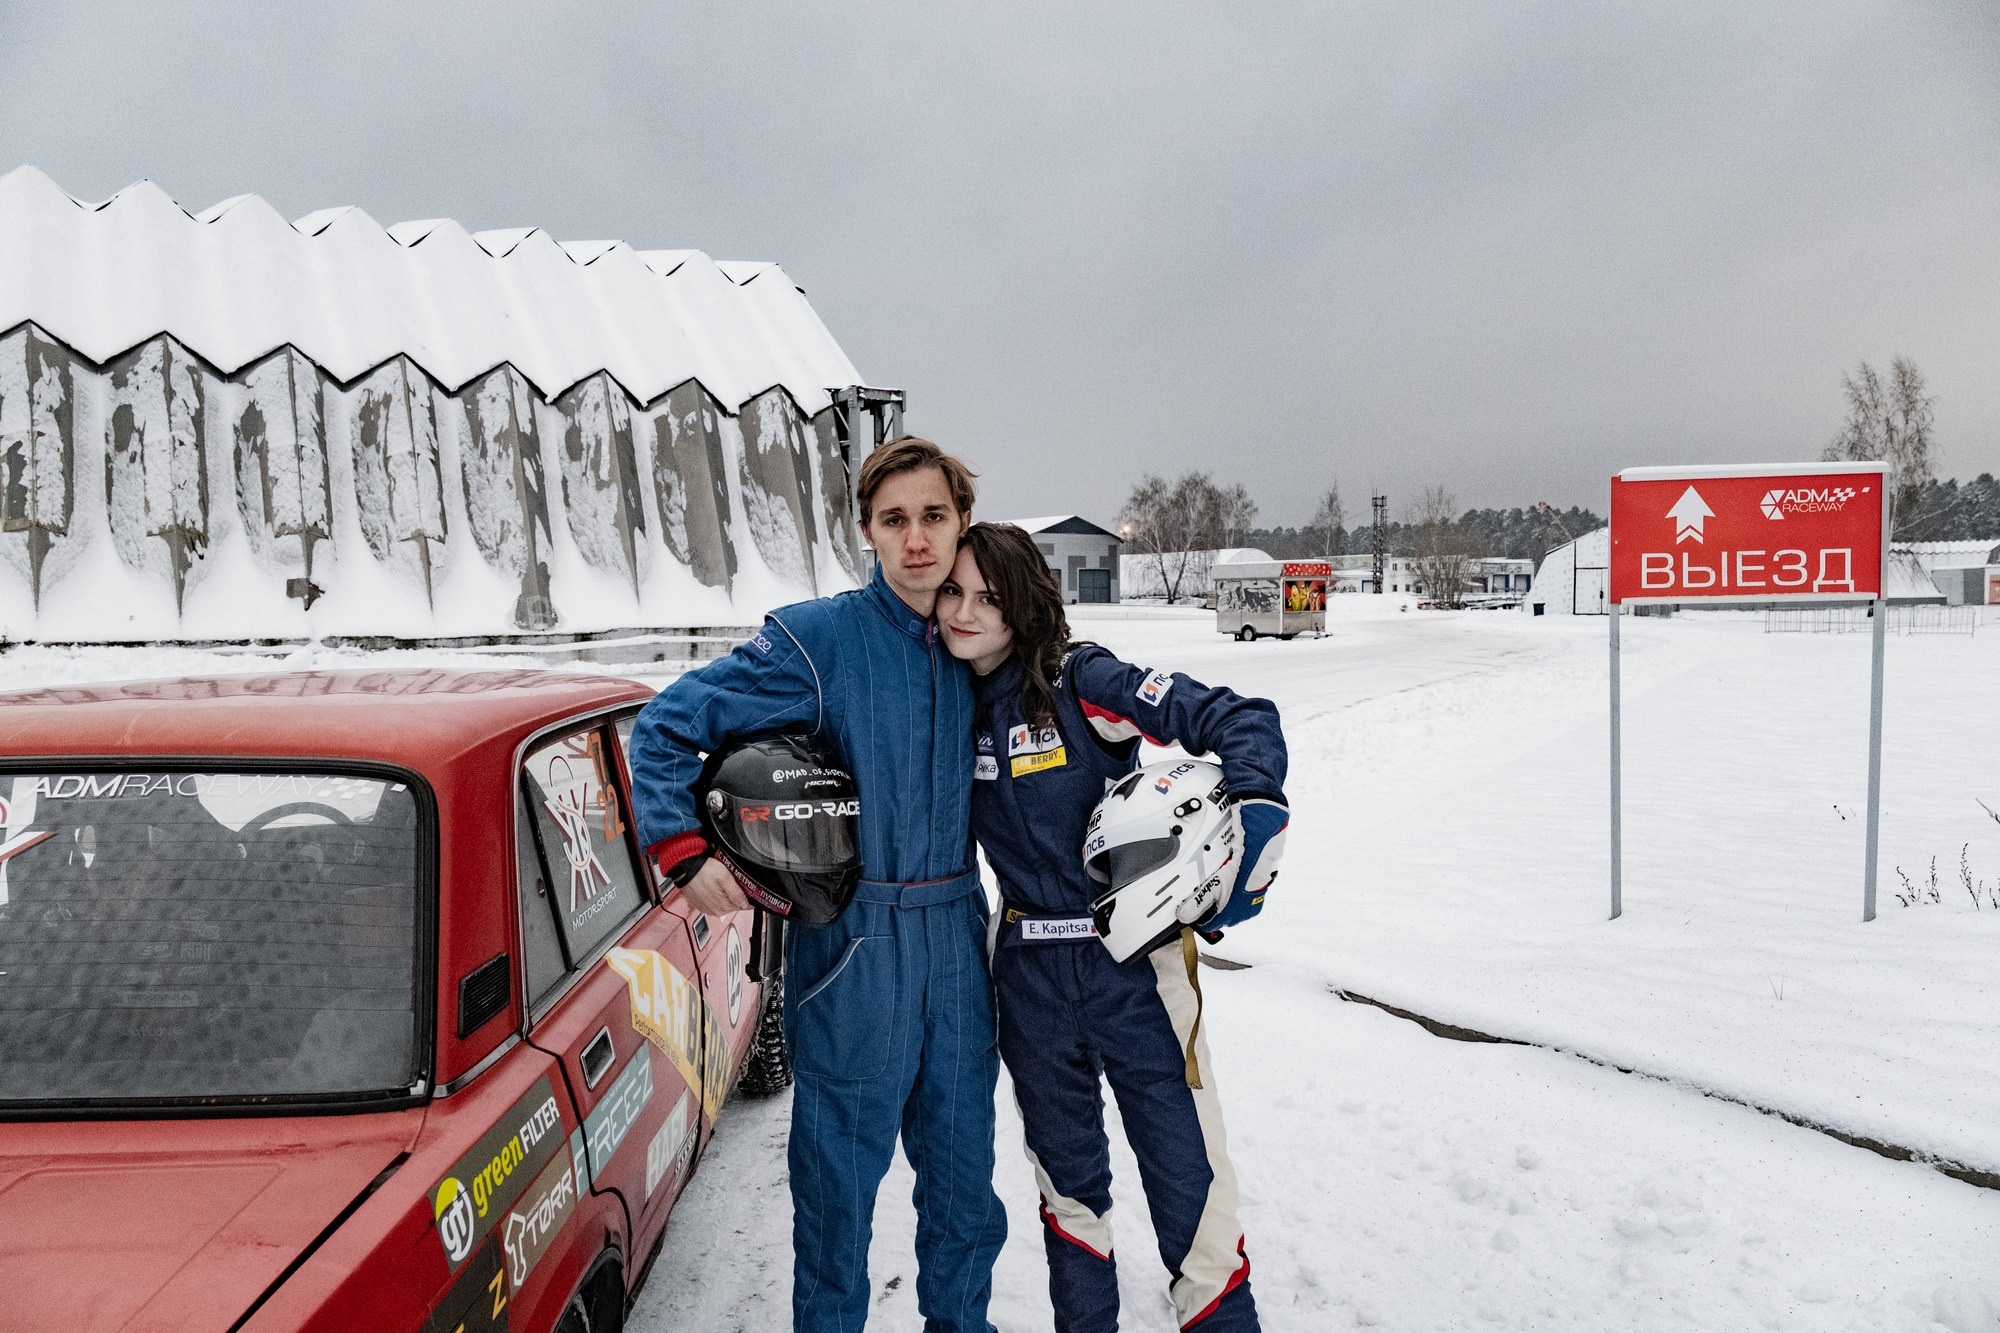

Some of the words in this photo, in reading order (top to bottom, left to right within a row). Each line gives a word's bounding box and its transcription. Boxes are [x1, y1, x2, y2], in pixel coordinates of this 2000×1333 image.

[1783, 488, 1829, 503] ADM
[1782, 502, 1845, 513] RACEWAY
[1641, 548, 1855, 593] ВЫЕЗД
[1168, 763, 1195, 780] ПСБ
[1086, 835, 1105, 857] ПСБ
[572, 886, 617, 932] MOTORSPORT
[1029, 923, 1040, 935] E.
[1043, 922, 1089, 936] Kapitsa
[473, 1135, 524, 1218] green
[520, 1096, 560, 1154] FILTER
